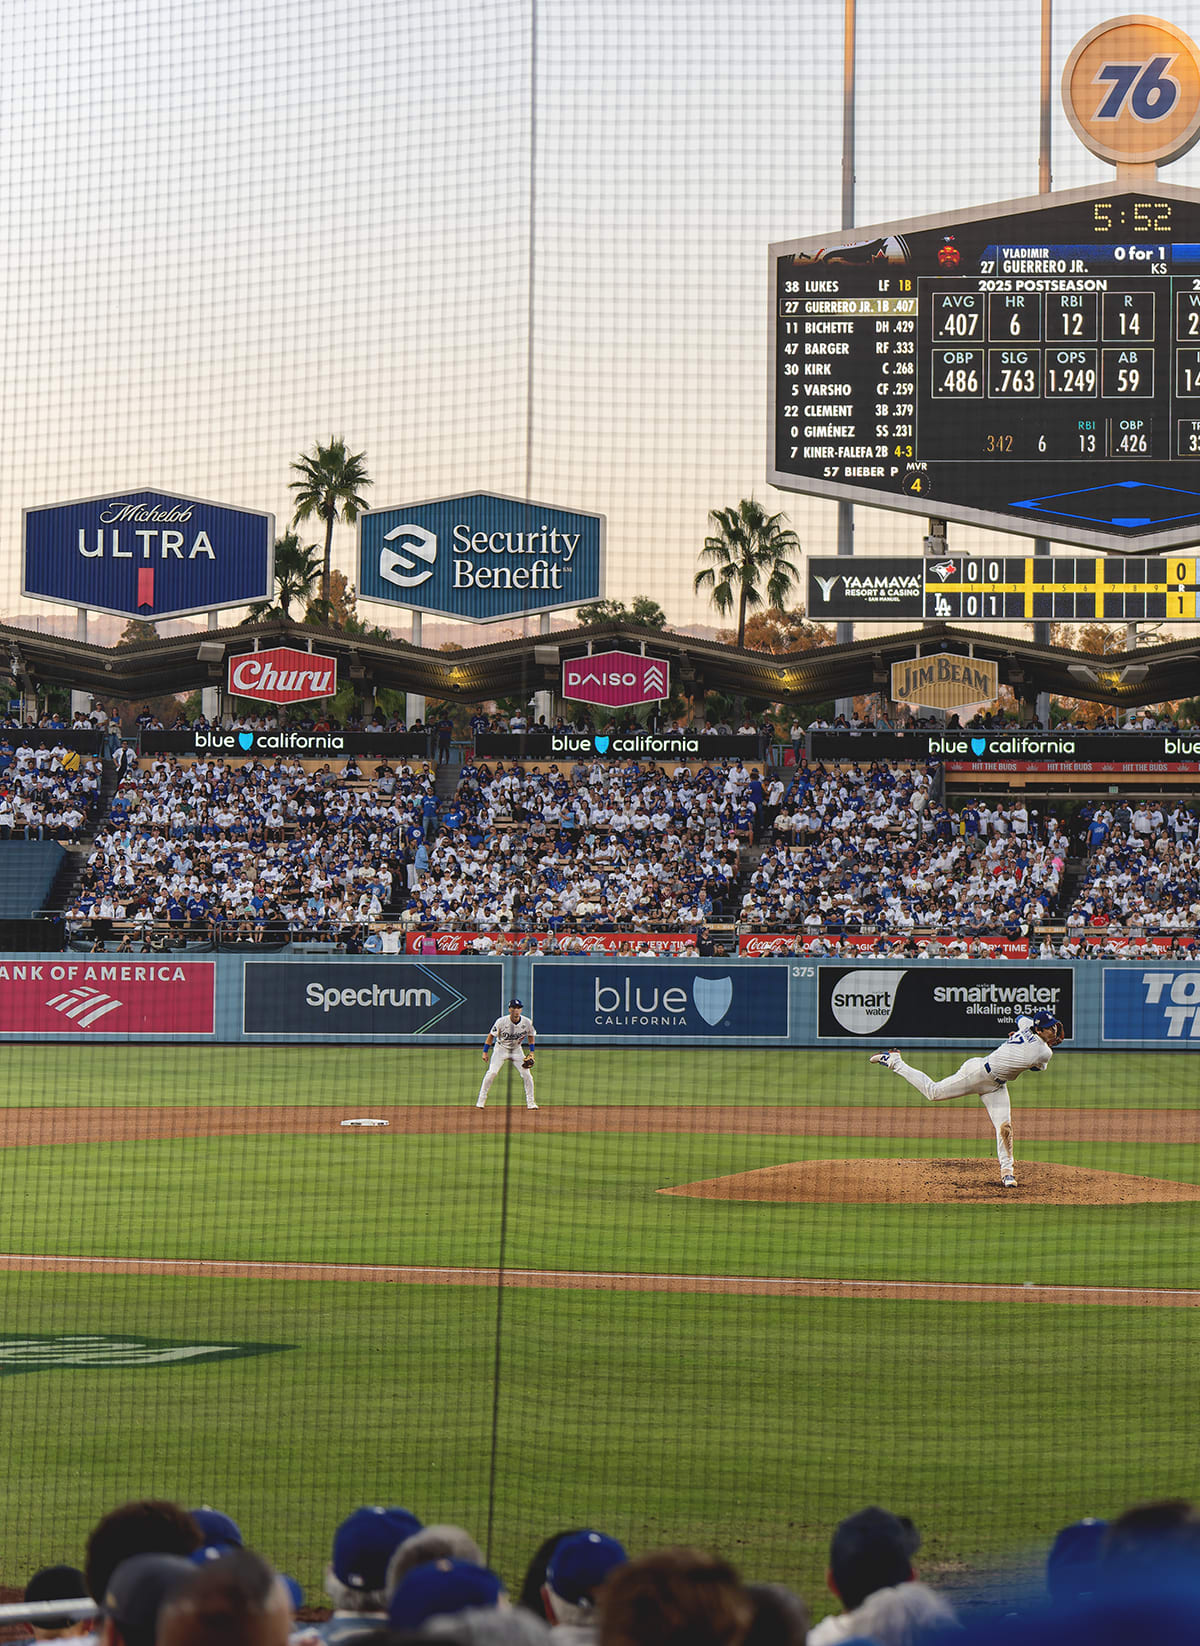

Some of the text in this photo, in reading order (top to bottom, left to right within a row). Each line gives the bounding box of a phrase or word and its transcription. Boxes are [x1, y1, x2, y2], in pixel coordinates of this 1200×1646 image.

[1090, 53, 1181, 123] 76
[1094, 203, 1172, 231] 5:52
[1003, 248, 1048, 258] VLADIMIR
[1115, 246, 1164, 260] 0 for 1
[981, 260, 1088, 273] 27 GUERRERO JR.
[785, 280, 911, 292] 38 LUKES LF 1B
[979, 280, 1107, 291] 2025 POSTSEASON
[943, 296, 974, 307] AVG
[1006, 296, 1024, 307] HR
[786, 321, 914, 333] 11 BICHETTE DH .429
[939, 314, 978, 335] .407
[1011, 314, 1020, 335] 6
[784, 363, 913, 375] 30 KIRK C .268
[824, 467, 898, 476] 57 BIEBER P
[99, 502, 196, 524] Michelob
[78, 528, 217, 560] ULTRA
[453, 524, 581, 562] Security
[453, 559, 563, 590] Benefit
[968, 561, 999, 582] 0 0
[1176, 562, 1186, 581] 0
[844, 589, 920, 597] RESORT & CASINO
[1178, 584, 1186, 593] R
[934, 592, 952, 617] LA
[967, 596, 997, 617] 0 1
[1177, 596, 1184, 615] 1
[233, 660, 331, 692] Churu
[568, 673, 637, 686] DAISO
[898, 658, 991, 698] JIM BEAM
[195, 732, 344, 749] blue california
[552, 735, 699, 752] blue california
[928, 737, 1075, 754] blue california
[971, 763, 982, 771] HIT
[983, 763, 997, 771] THE
[0, 966, 187, 982] ANK OF AMERICA
[792, 967, 815, 978] 375
[305, 982, 432, 1013] Spectrum
[595, 976, 688, 1013] blue
[834, 991, 891, 1008] smart
[933, 983, 1061, 1004] smartwater
[865, 1008, 891, 1016] water
[966, 1004, 1011, 1015] alkaline
[595, 1016, 688, 1026] CALIFORNIA
[997, 1016, 1014, 1024] with
